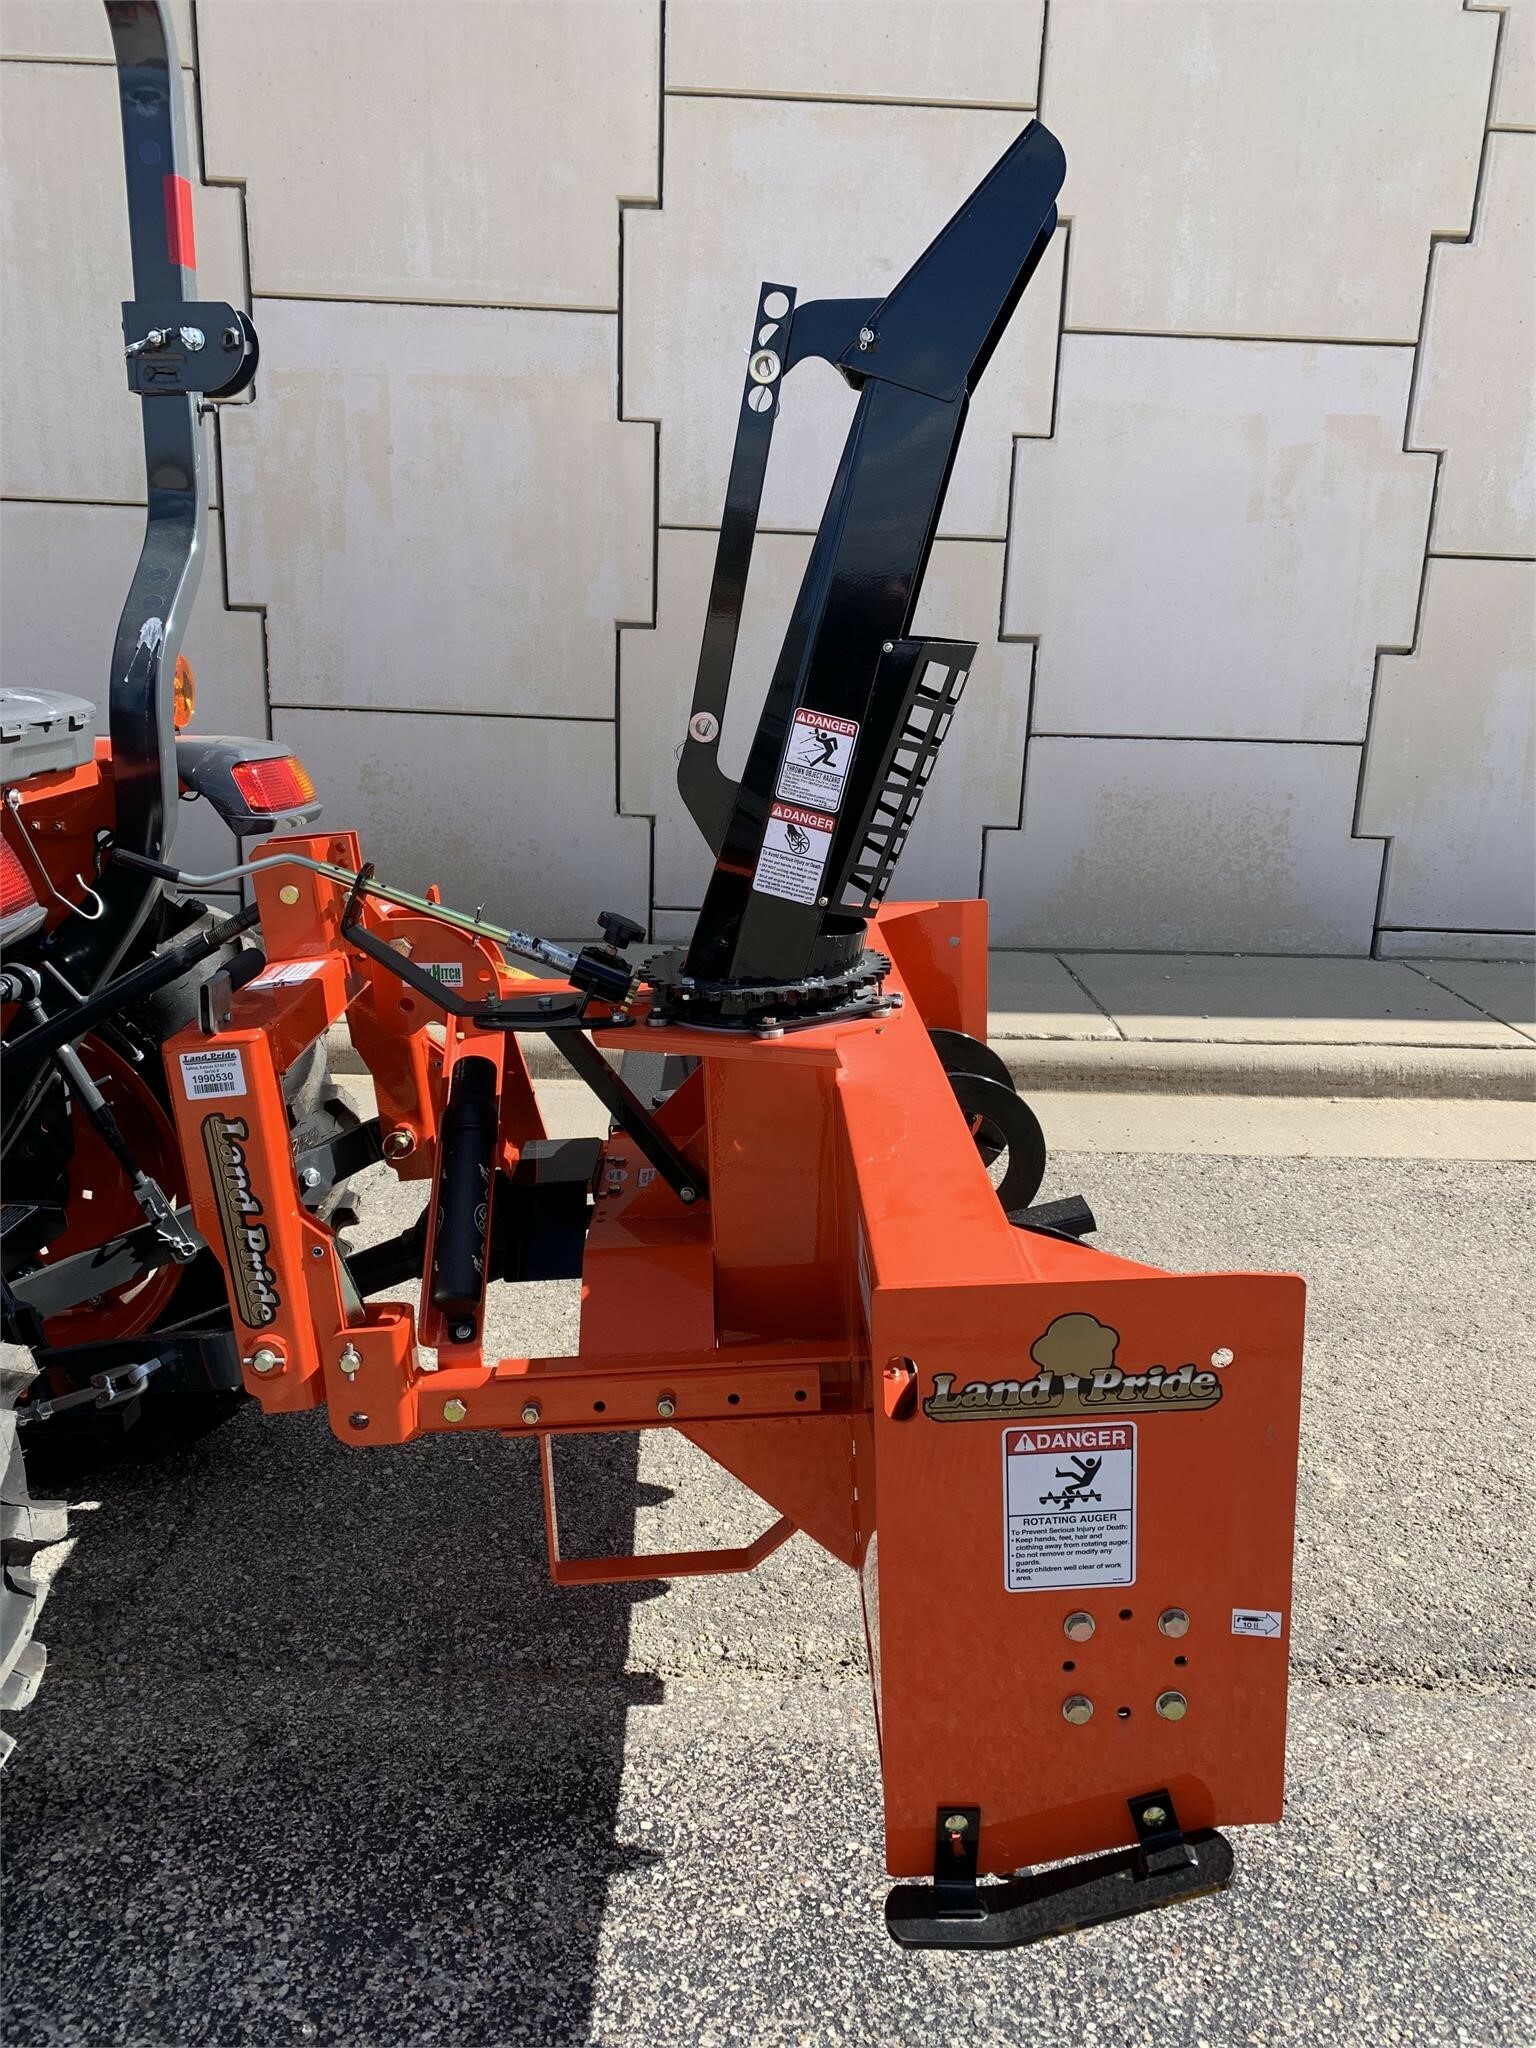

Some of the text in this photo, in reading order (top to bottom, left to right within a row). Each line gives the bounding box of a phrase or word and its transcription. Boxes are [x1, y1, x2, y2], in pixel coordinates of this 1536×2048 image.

[807, 713, 856, 735] DANGER
[786, 764, 841, 784] THROWN OBJECT HAZARD
[783, 809, 833, 830] DANGER
[183, 1052, 237, 1062] Land Pride
[192, 1072, 233, 1084] 1990530
[215, 1120, 279, 1325] Land Pride
[931, 1366, 1217, 1408] Land Pride
[1036, 1430, 1126, 1449] DANGER
[1023, 1514, 1117, 1526] ROTATING AUGER
[1016, 1544, 1043, 1552] clothing
